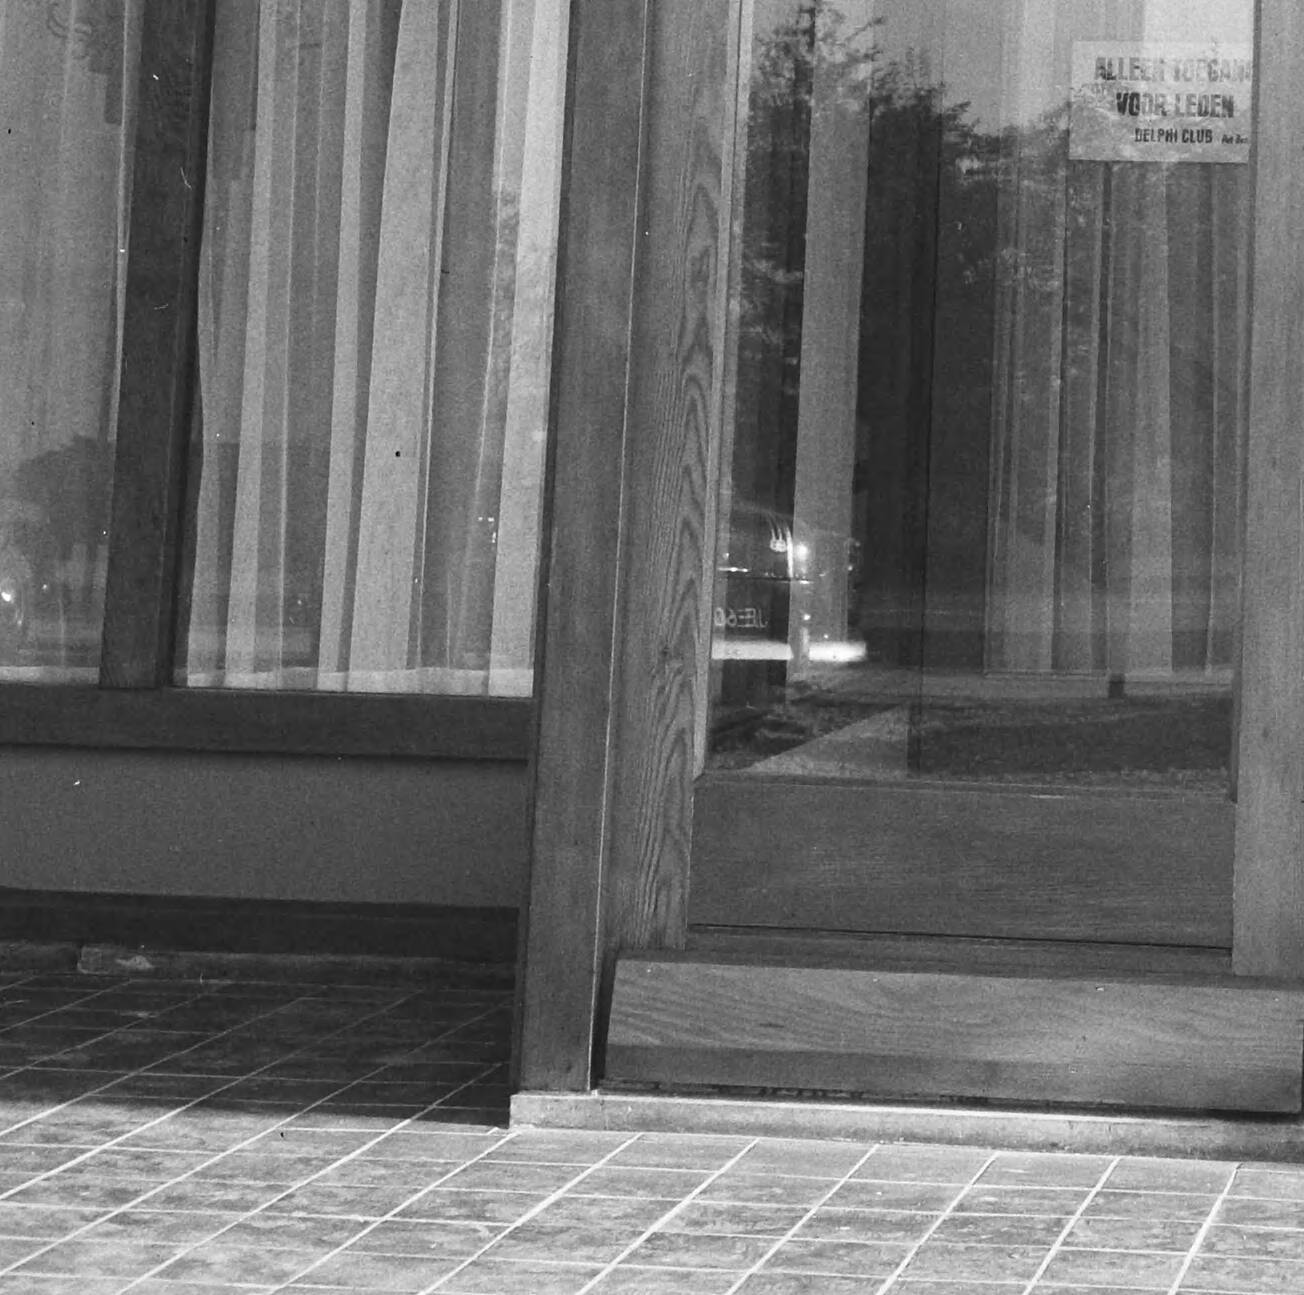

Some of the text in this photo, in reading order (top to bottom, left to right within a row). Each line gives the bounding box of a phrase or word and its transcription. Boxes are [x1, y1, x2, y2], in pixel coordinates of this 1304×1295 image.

[1116, 91, 1234, 119] VOOR LEDEN
[1134, 128, 1178, 143] DELPHI
[1180, 128, 1213, 144] CLUB
